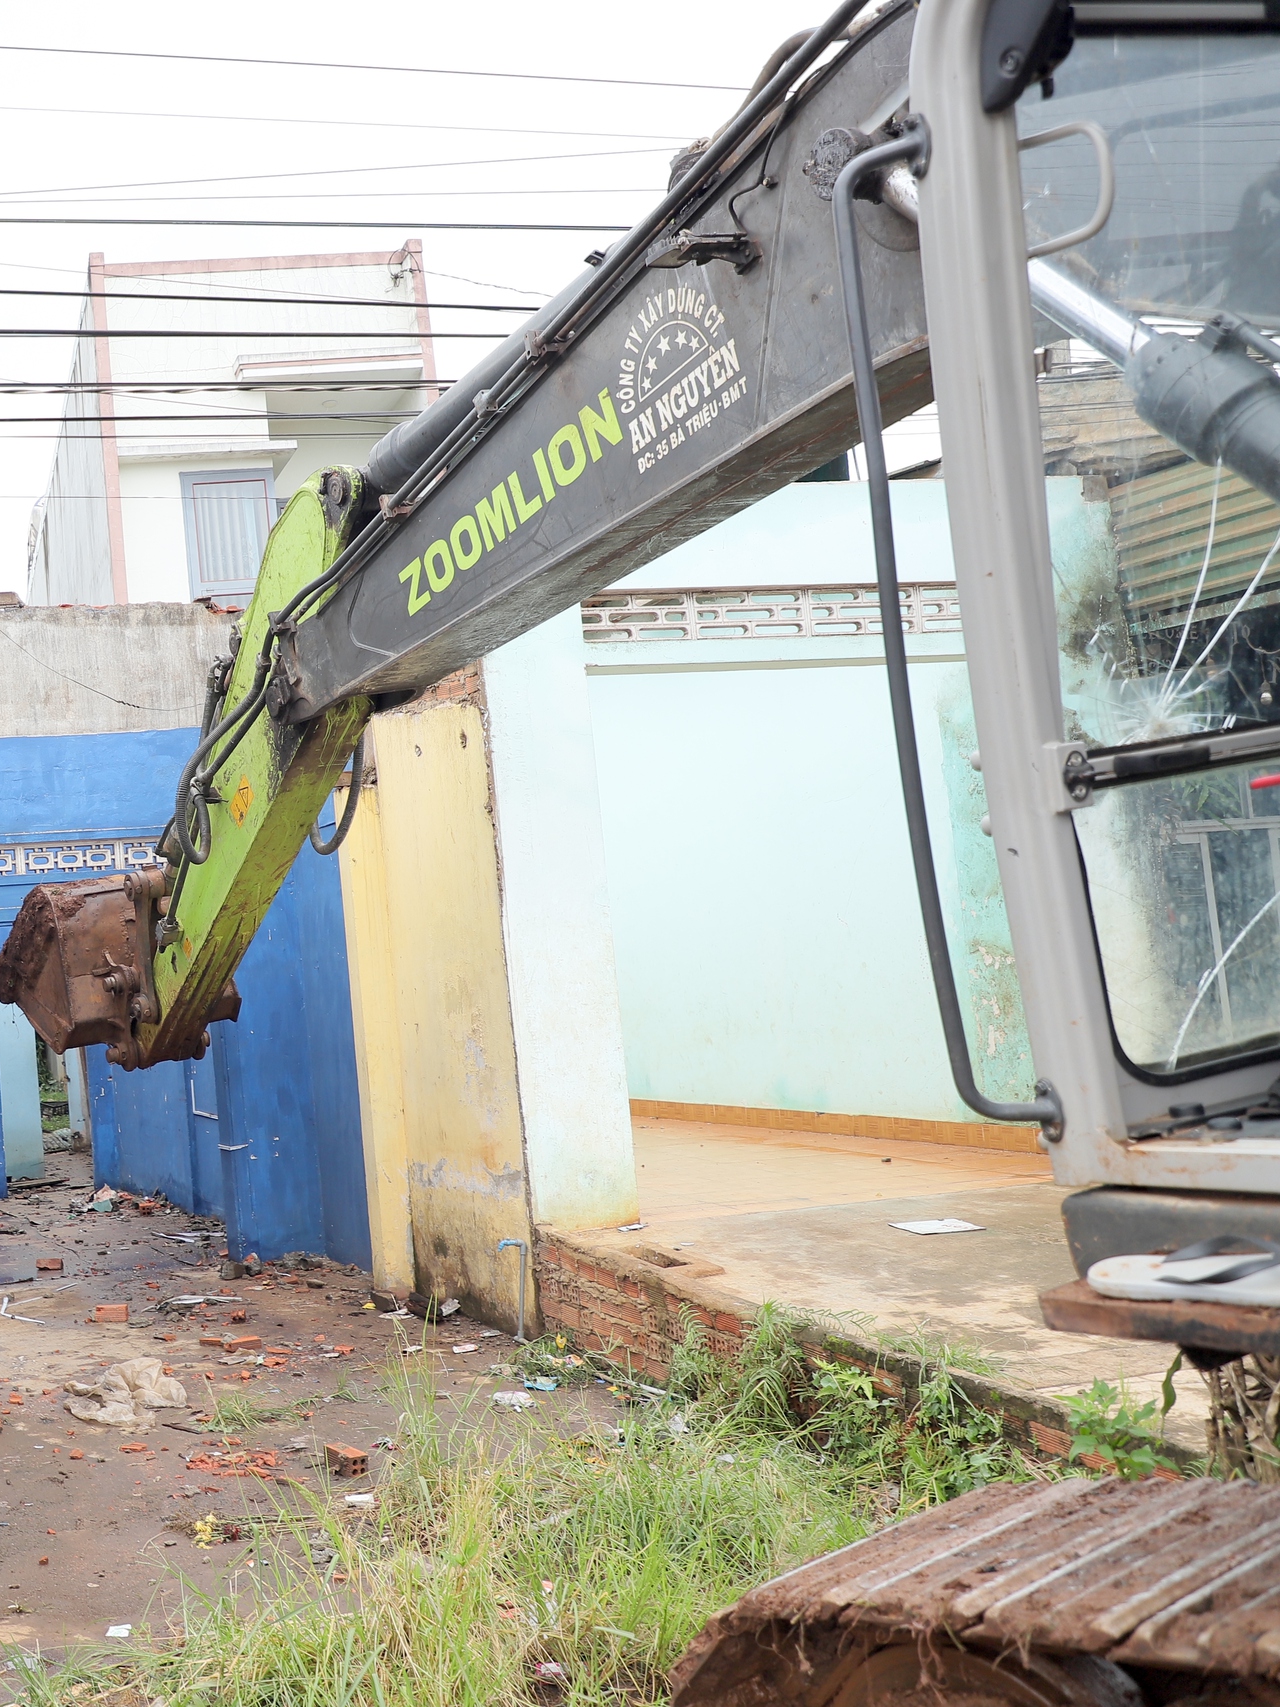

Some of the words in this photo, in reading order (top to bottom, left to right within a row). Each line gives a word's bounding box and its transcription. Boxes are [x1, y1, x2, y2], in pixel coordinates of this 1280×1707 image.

[637, 293, 664, 333] XÂY
[667, 282, 705, 320] DỰNG
[624, 325, 643, 354] TY
[616, 358, 636, 414] CÔNG
[628, 407, 657, 454] AN
[656, 338, 741, 432] NGUYÊN
[656, 439, 669, 461] 35
[670, 423, 686, 450] BÀ
[398, 387, 624, 617] ZOOMLION
